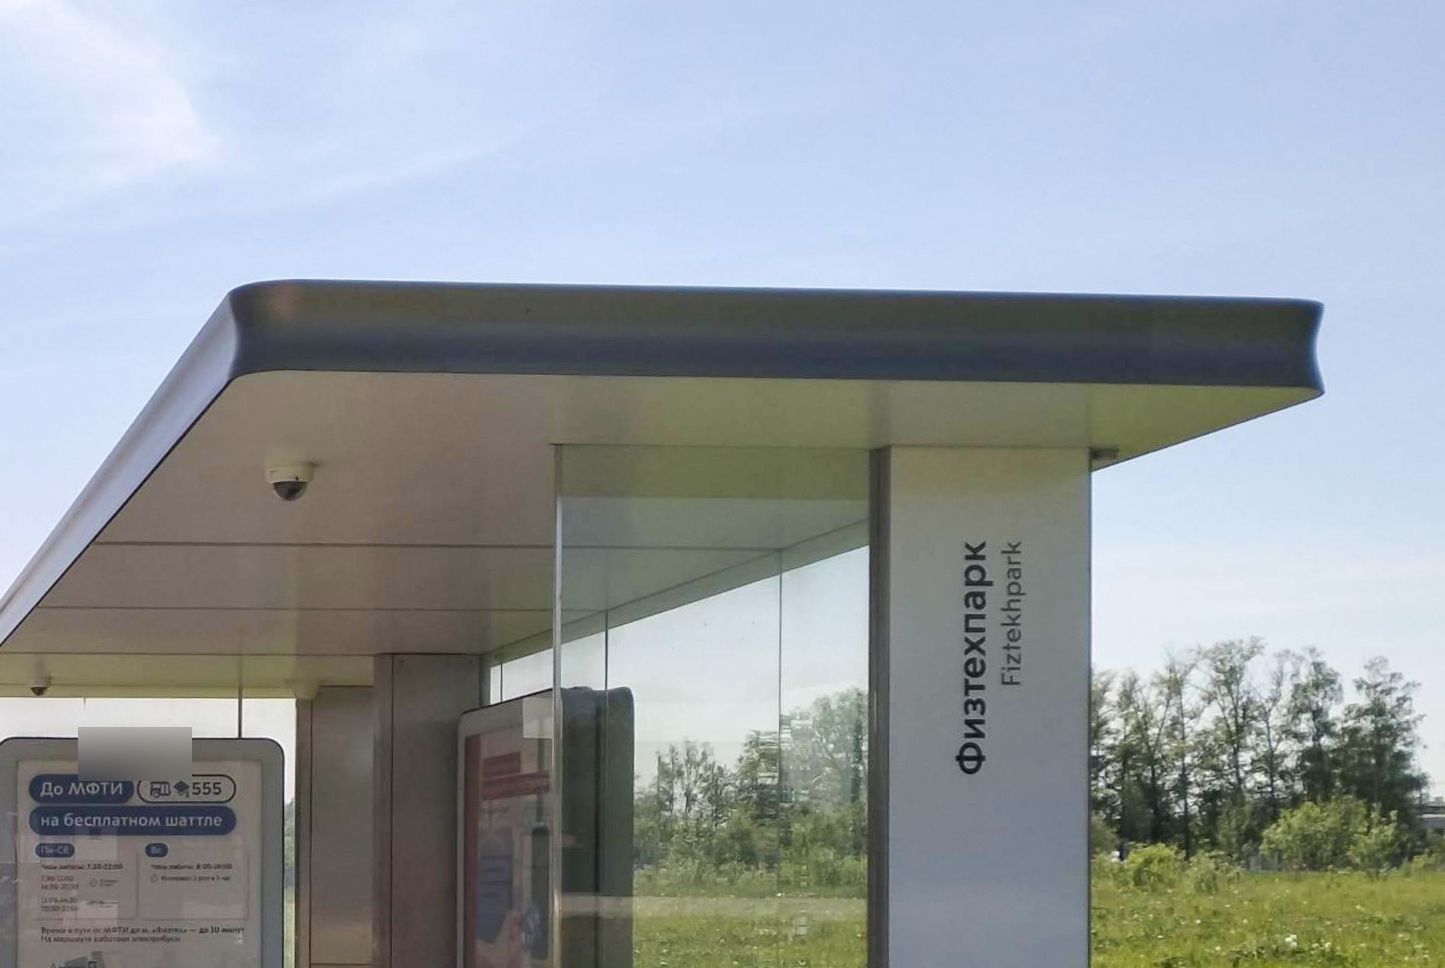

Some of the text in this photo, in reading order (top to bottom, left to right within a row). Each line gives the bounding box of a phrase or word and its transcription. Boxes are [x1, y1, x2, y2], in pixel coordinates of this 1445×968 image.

[1000, 541, 1026, 686] Fiztekhpark
[956, 541, 994, 775] Физтехпарк
[39, 780, 223, 798] До МФТИ 555
[40, 812, 224, 828] на бесплатном шаттле
